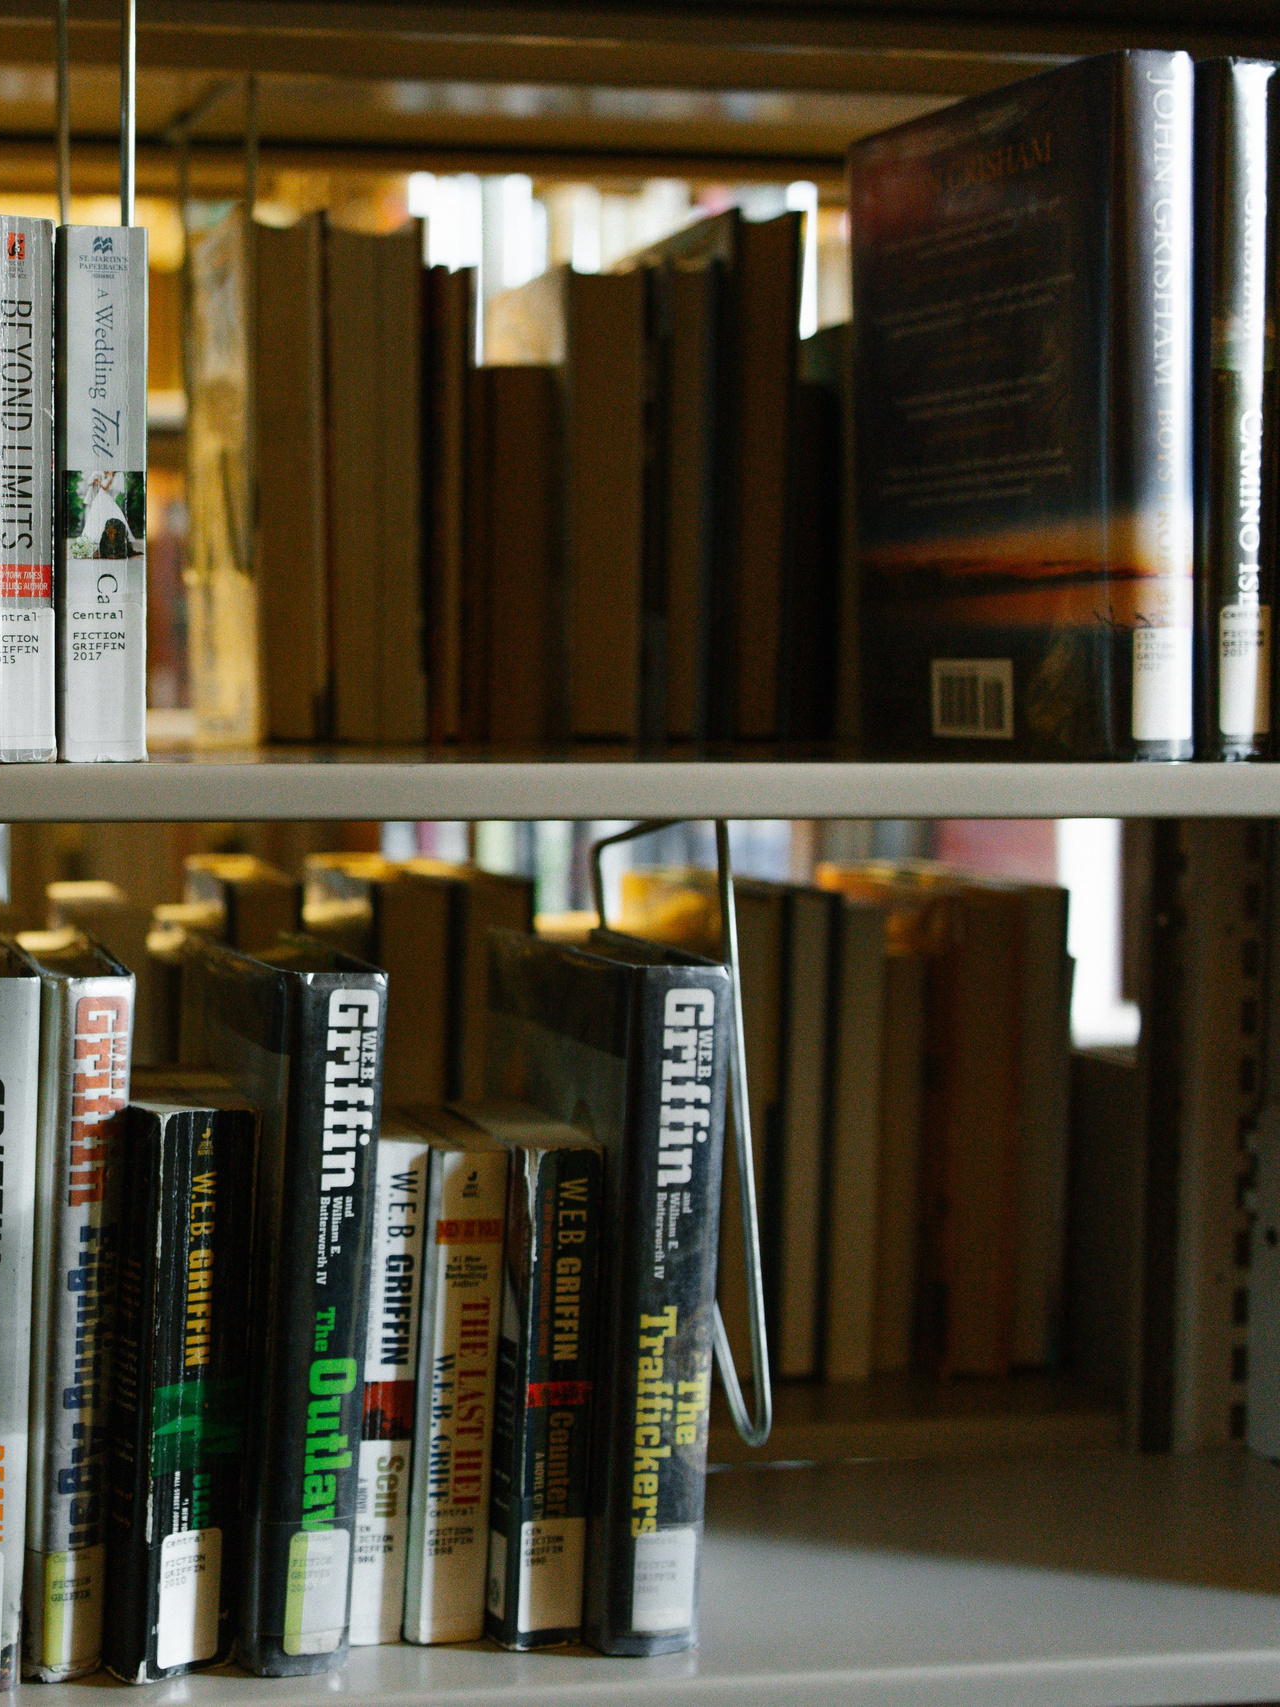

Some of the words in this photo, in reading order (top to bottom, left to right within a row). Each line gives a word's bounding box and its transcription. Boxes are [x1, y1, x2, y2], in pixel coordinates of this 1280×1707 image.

[1146, 71, 1175, 181] JOHN
[97, 289, 109, 299] A
[1153, 198, 1175, 386] GRISHAM
[1, 300, 32, 431] BEYOND
[88, 305, 114, 399] Wedding
[92, 407, 120, 458] Tail
[1240, 407, 1263, 552] CAMINO
[1, 445, 33, 550] LIMITS
[320, 989, 379, 1191] Griffin
[658, 988, 715, 1187] Griffin
[190, 1172, 217, 1242] W.E.B.
[386, 1171, 419, 1245] W.E.B.
[557, 1178, 588, 1250] W.E.B.
[185, 1249, 215, 1366] GRIFFIN
[314, 1305, 336, 1352] The
[380, 1253, 415, 1366] GRIFFIN
[553, 1258, 582, 1361] GRIFFIN
[631, 1305, 678, 1537] Traffickers
